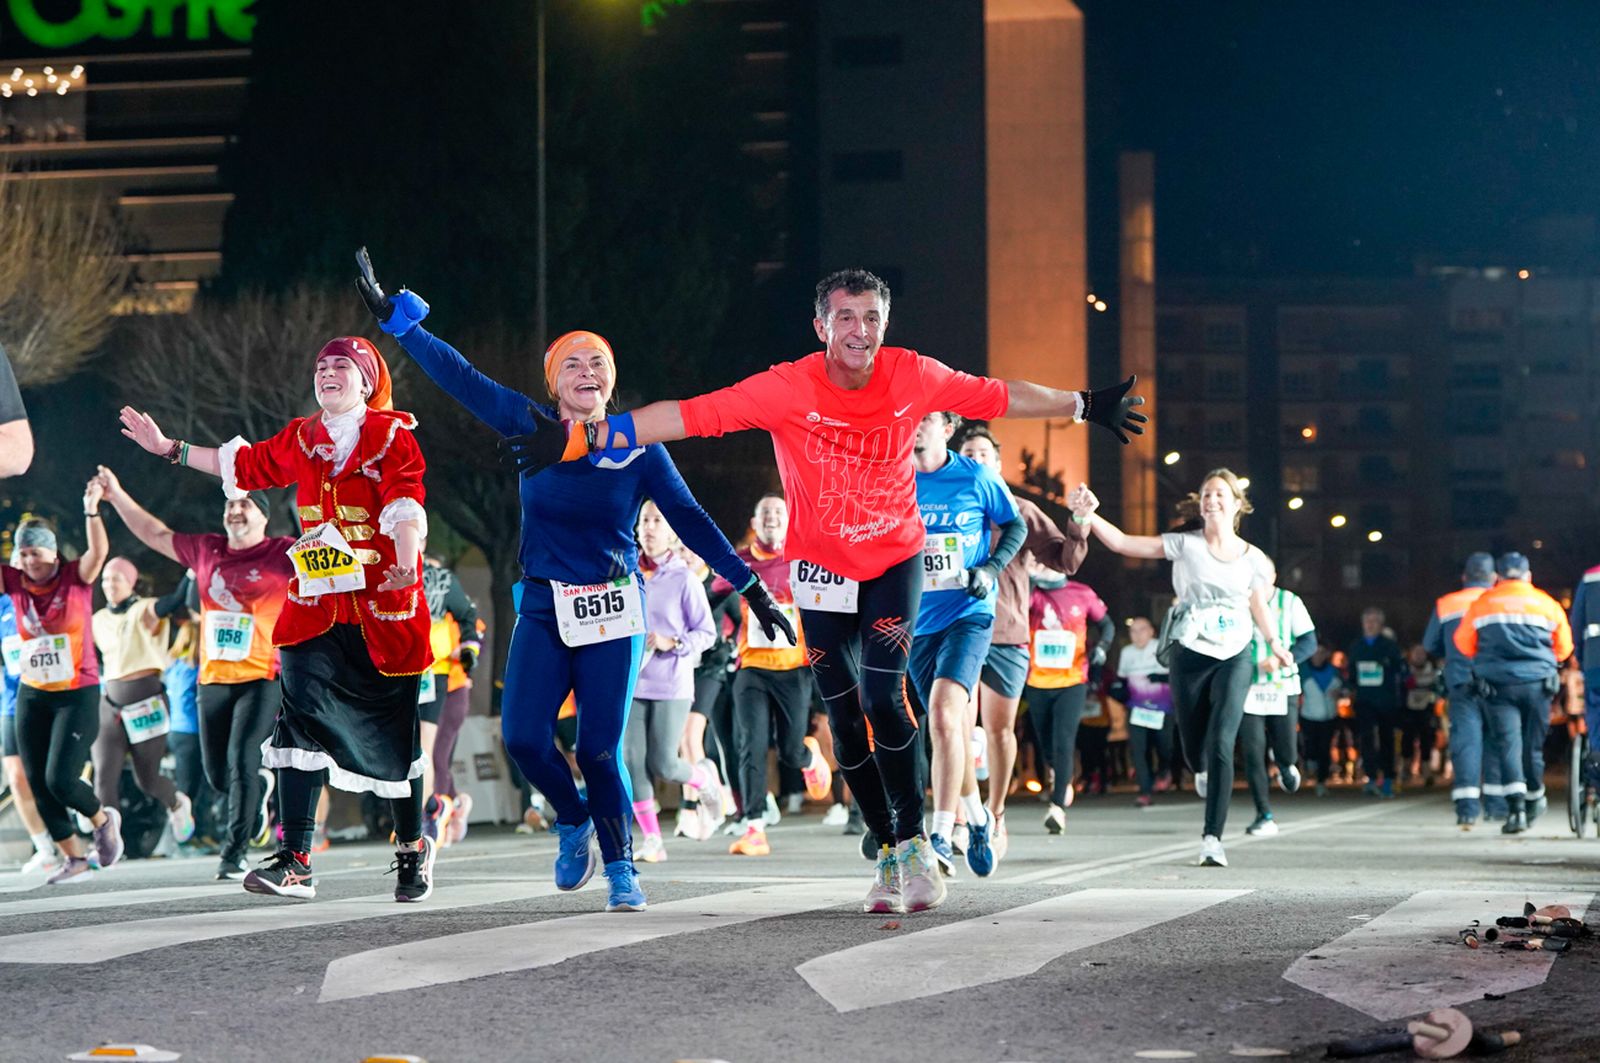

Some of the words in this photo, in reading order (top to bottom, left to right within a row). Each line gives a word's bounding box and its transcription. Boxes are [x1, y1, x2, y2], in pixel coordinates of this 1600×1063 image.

[924, 554, 951, 572] 931
[563, 588, 581, 597] SAN
[573, 590, 625, 620] 6515
[30, 652, 60, 668] 6731
